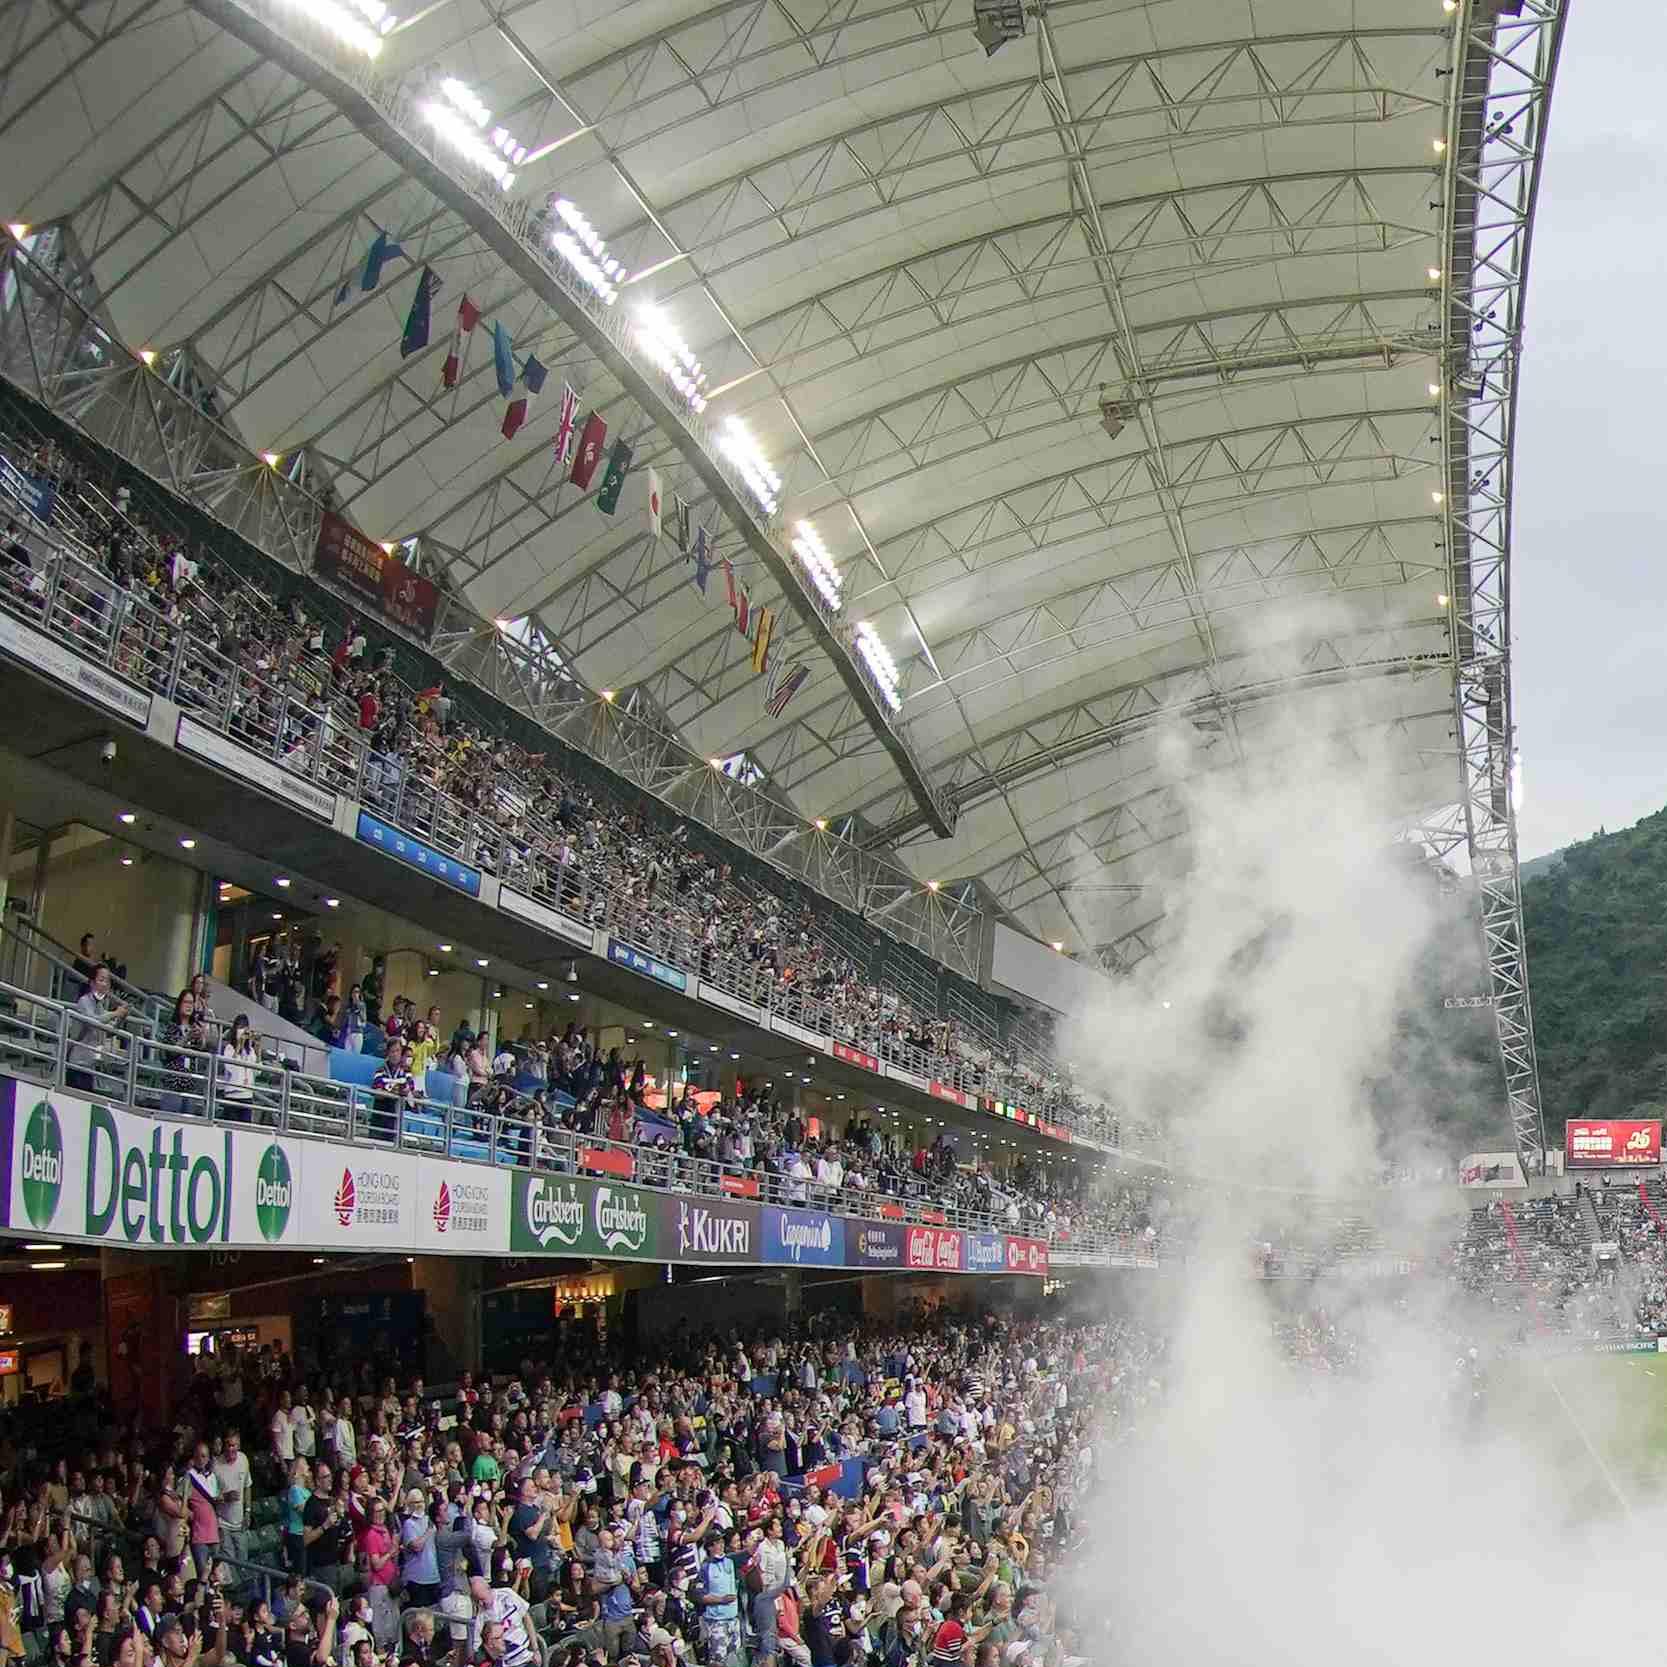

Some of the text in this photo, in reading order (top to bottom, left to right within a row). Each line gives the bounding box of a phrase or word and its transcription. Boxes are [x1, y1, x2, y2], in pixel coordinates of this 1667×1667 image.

[23, 1142, 62, 1186] Dettol
[85, 1103, 233, 1244] Dettol
[256, 1176, 292, 1209] Dettol
[527, 1178, 584, 1246] Carlsberg
[596, 1187, 647, 1248] Carlsberg
[694, 1208, 749, 1253] KUKRI
